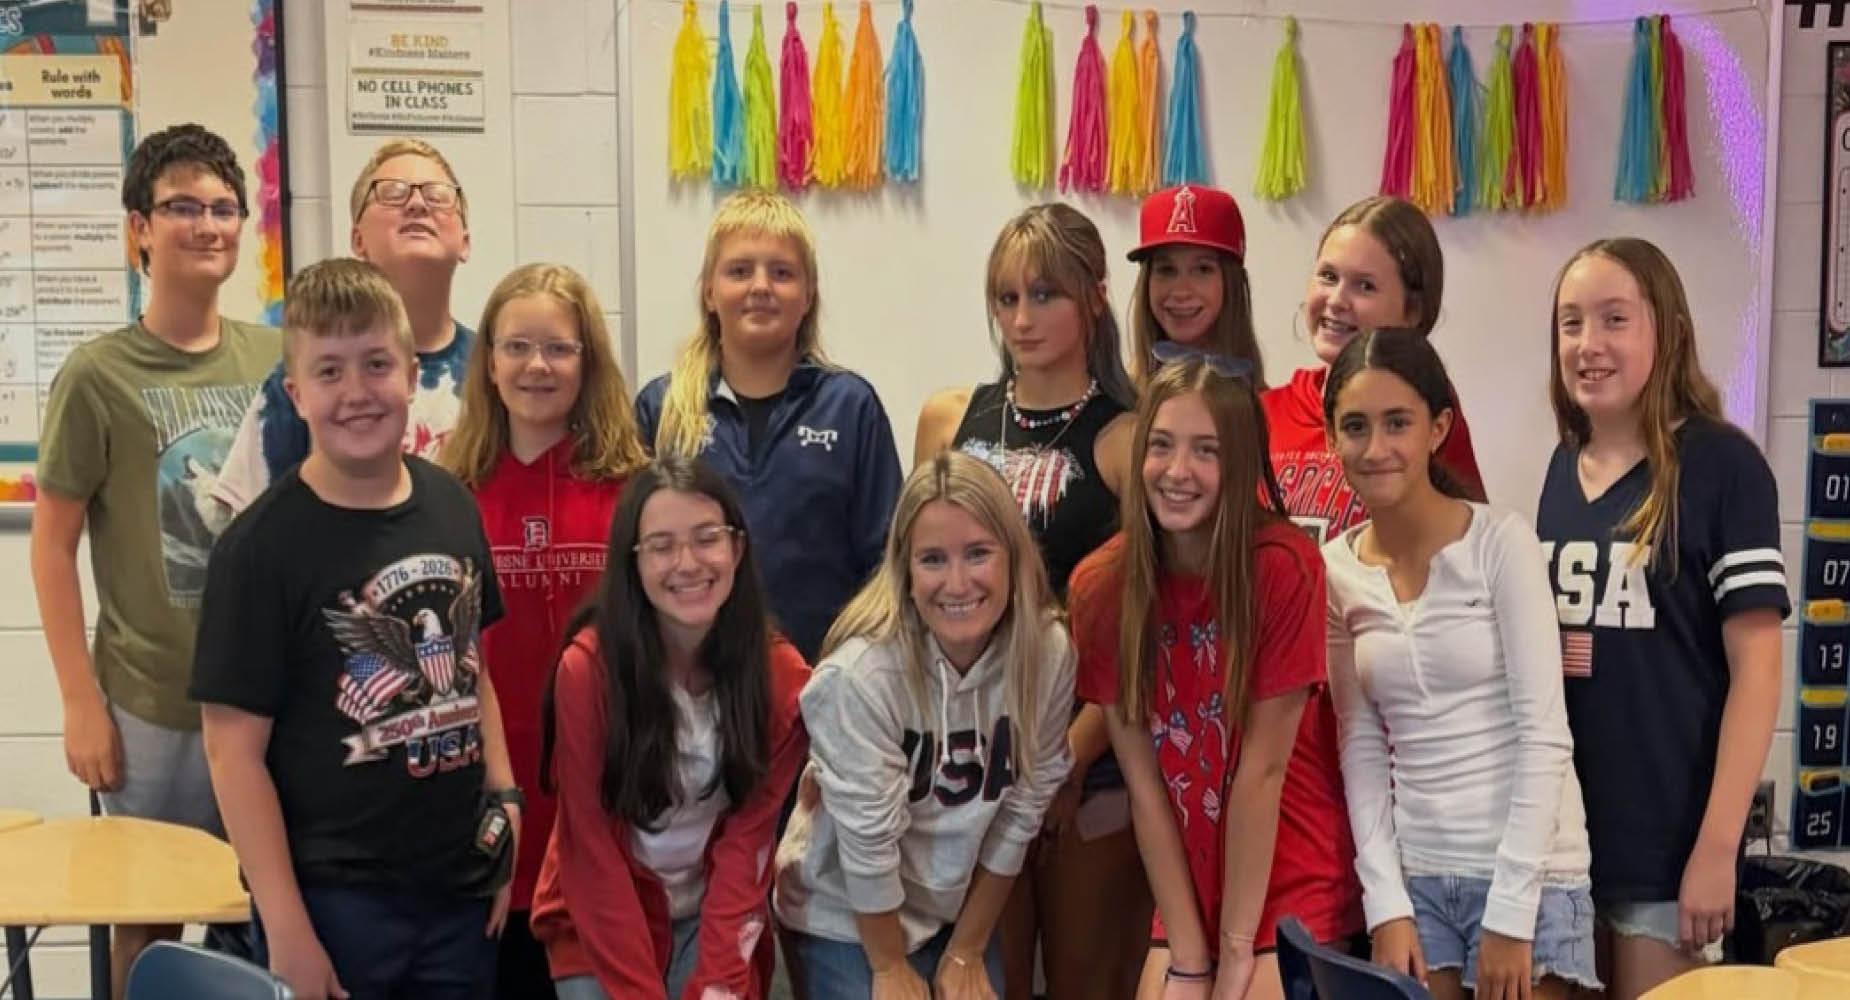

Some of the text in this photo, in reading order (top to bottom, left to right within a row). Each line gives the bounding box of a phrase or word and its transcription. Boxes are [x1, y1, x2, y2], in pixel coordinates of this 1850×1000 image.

[391, 33, 449, 49] BE KIND
[41, 69, 101, 83] Rule with
[357, 80, 474, 95] NO CELL PHONES
[51, 84, 93, 99] words
[384, 95, 448, 109] IN CLASS
[1166, 186, 1198, 233] A
[1825, 474, 1850, 500] 01
[376, 566, 409, 594] 1776
[420, 559, 452, 577] 2026
[1541, 540, 1656, 629] SA
[1823, 560, 1850, 586] 07
[1819, 644, 1843, 670] 13
[1813, 724, 1838, 750] 19
[1806, 810, 1833, 837] 25
